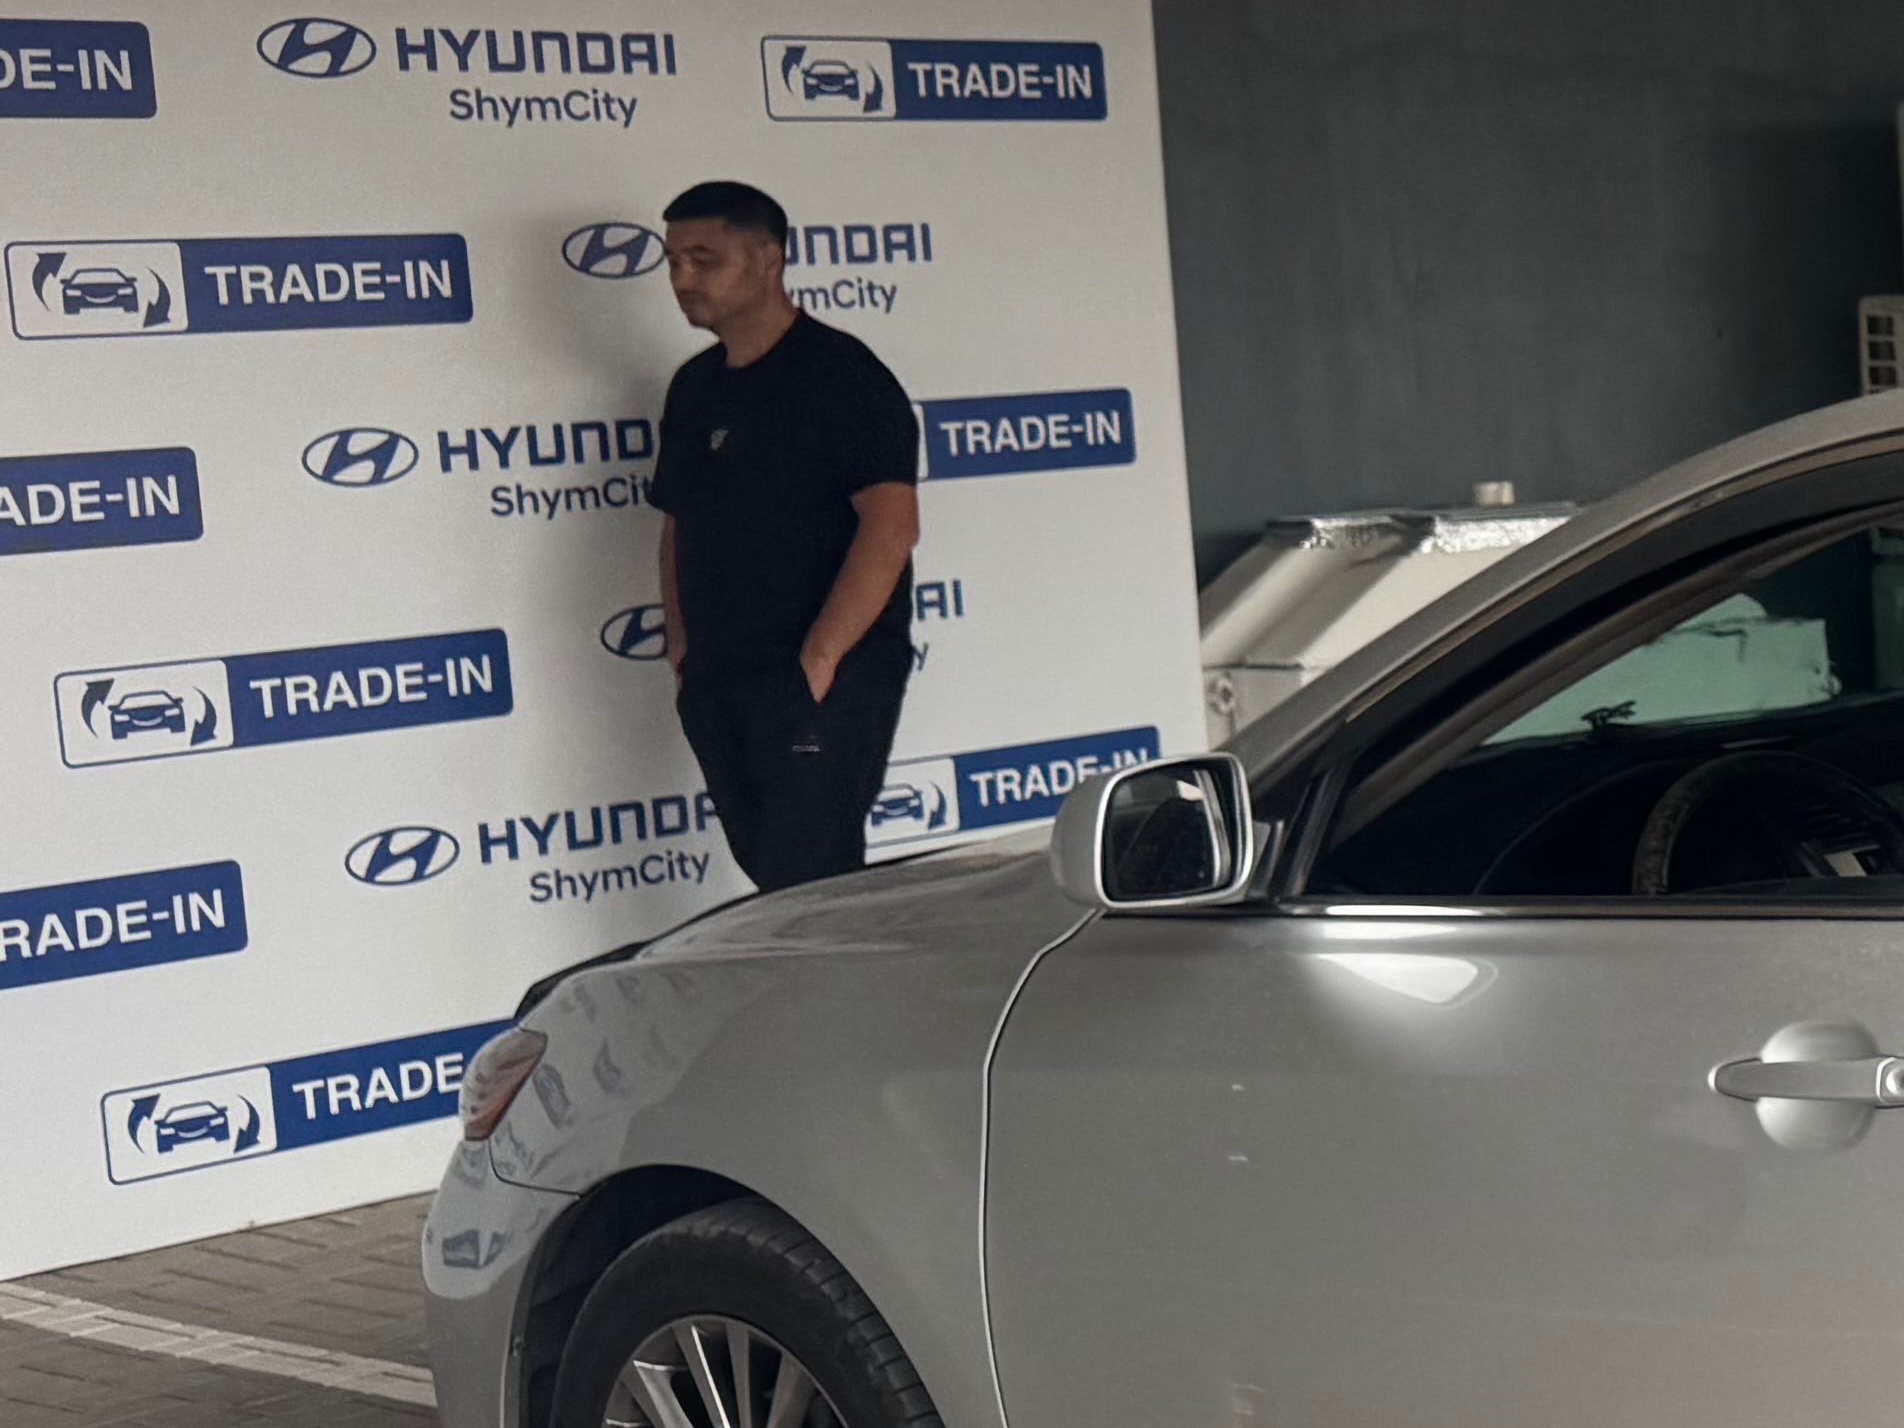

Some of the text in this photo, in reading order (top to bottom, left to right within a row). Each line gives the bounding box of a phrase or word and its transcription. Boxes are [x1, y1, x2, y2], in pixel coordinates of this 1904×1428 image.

[395, 27, 677, 76] HYUNDAI
[907, 62, 1092, 99] TRADE-IN
[449, 87, 638, 129] ShymCity
[786, 223, 932, 266] NDAI
[203, 259, 452, 305] TRADE-IN
[790, 277, 897, 314] mCity
[437, 418, 655, 473] HYUND
[939, 410, 1121, 456] TRADE-IN
[0, 474, 180, 526] ADE-IN
[491, 475, 656, 521] ShymCit
[249, 655, 492, 718] TRADE-IN
[478, 792, 718, 865] HYUNDA
[530, 850, 710, 903] ShymCity
[0, 888, 225, 962] RADE-IN
[291, 1051, 464, 1121] TRADE
